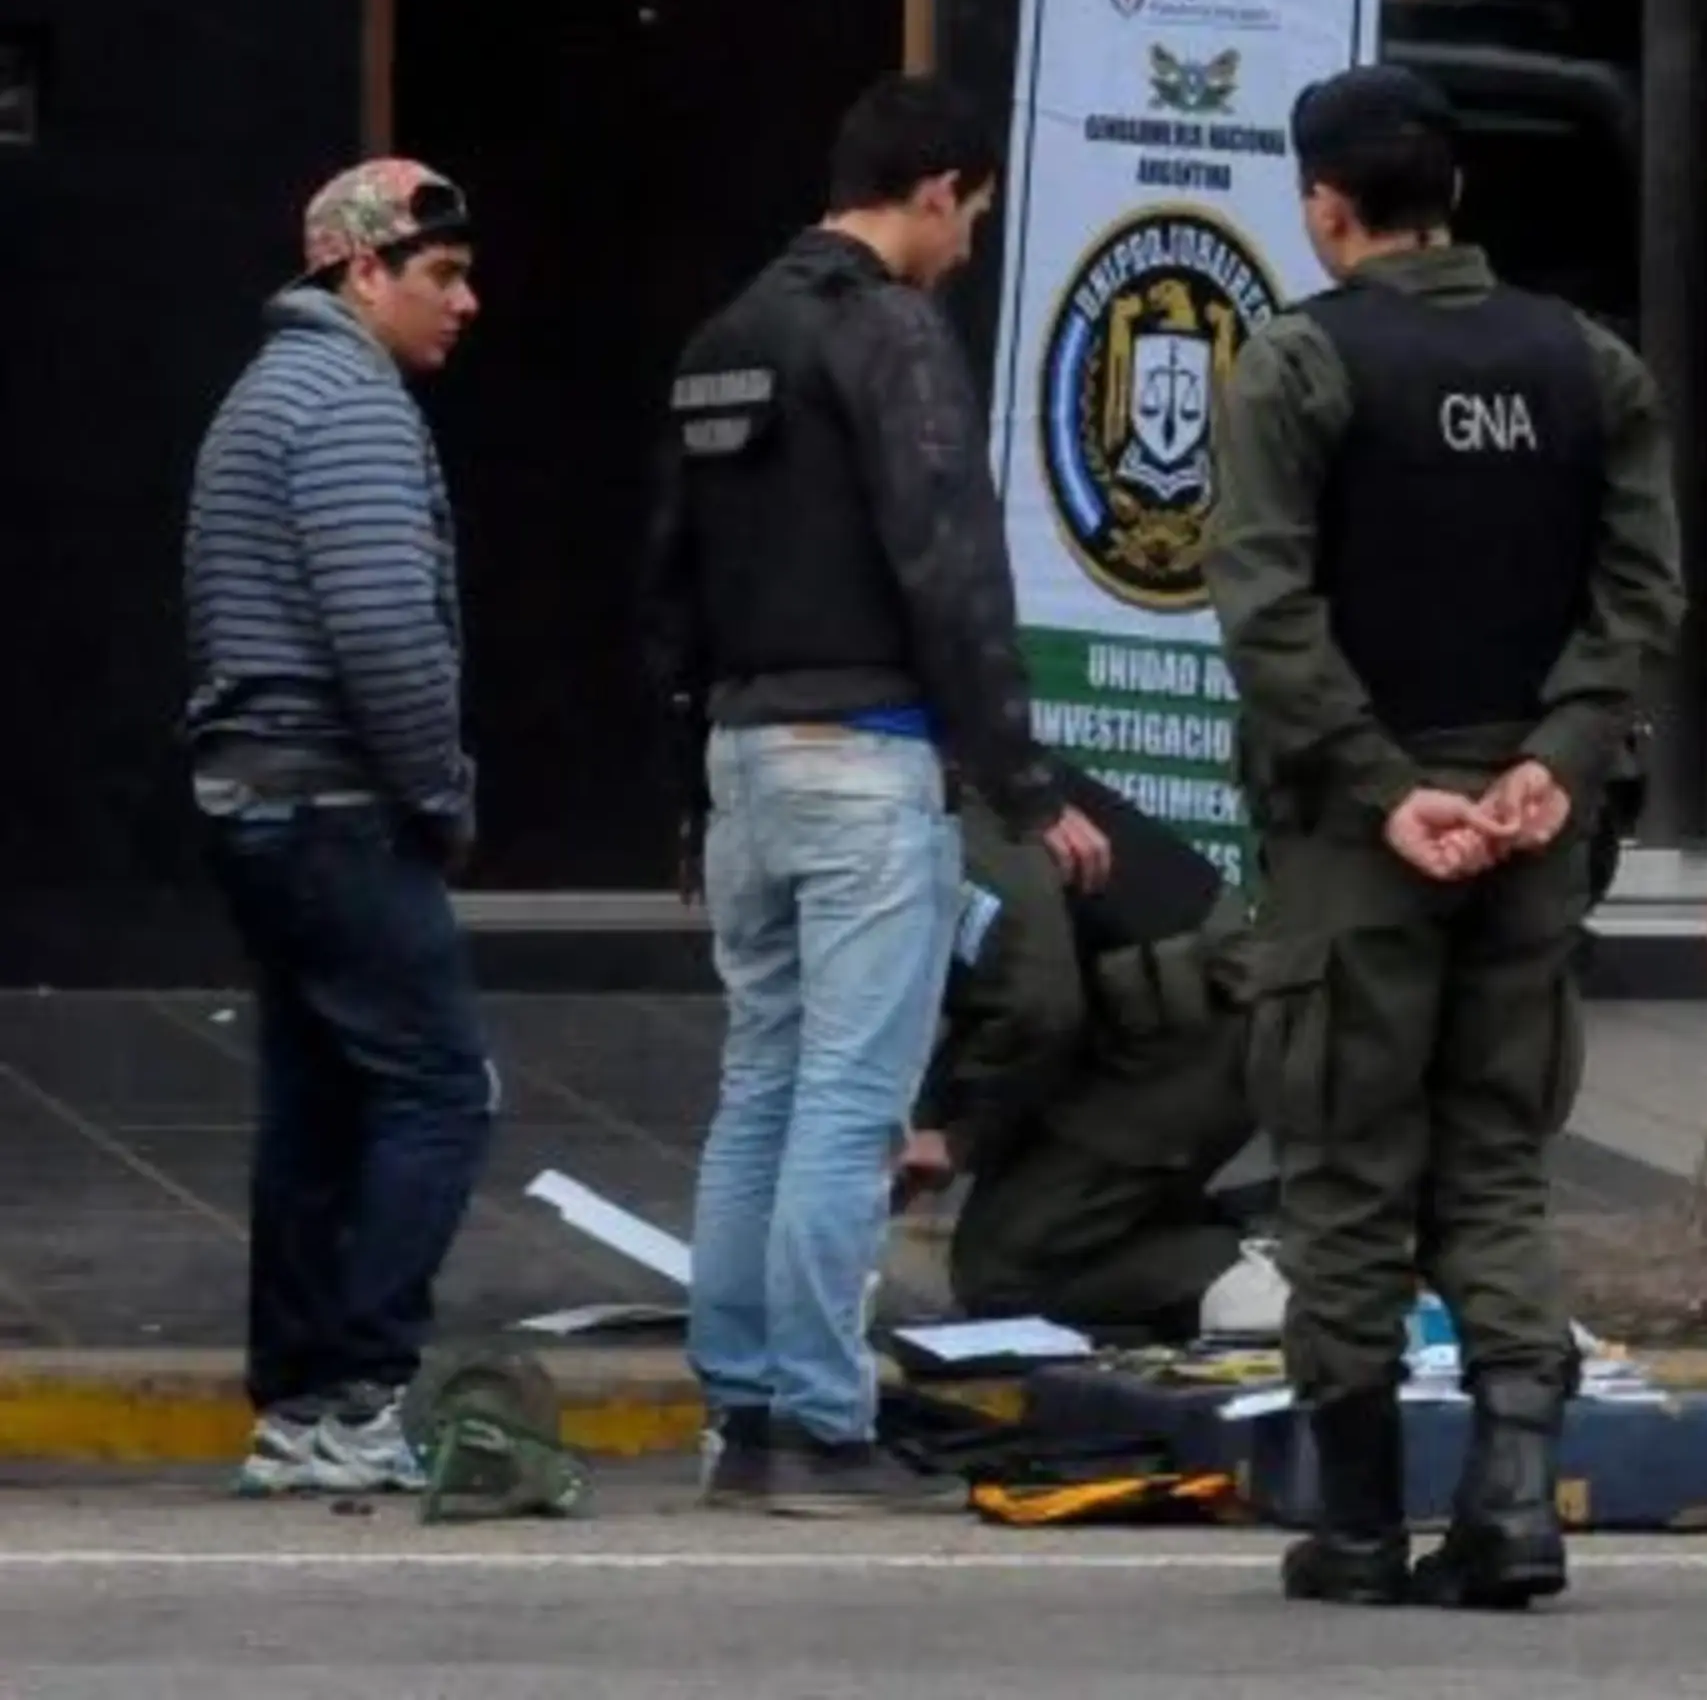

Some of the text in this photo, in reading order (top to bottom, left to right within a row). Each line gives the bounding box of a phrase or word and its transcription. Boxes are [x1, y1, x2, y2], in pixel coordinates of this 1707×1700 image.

[1439, 392, 1537, 451] GNA
[1088, 644, 1197, 696] UNIDAD
[1029, 698, 1233, 764] INVESTIGACIO
